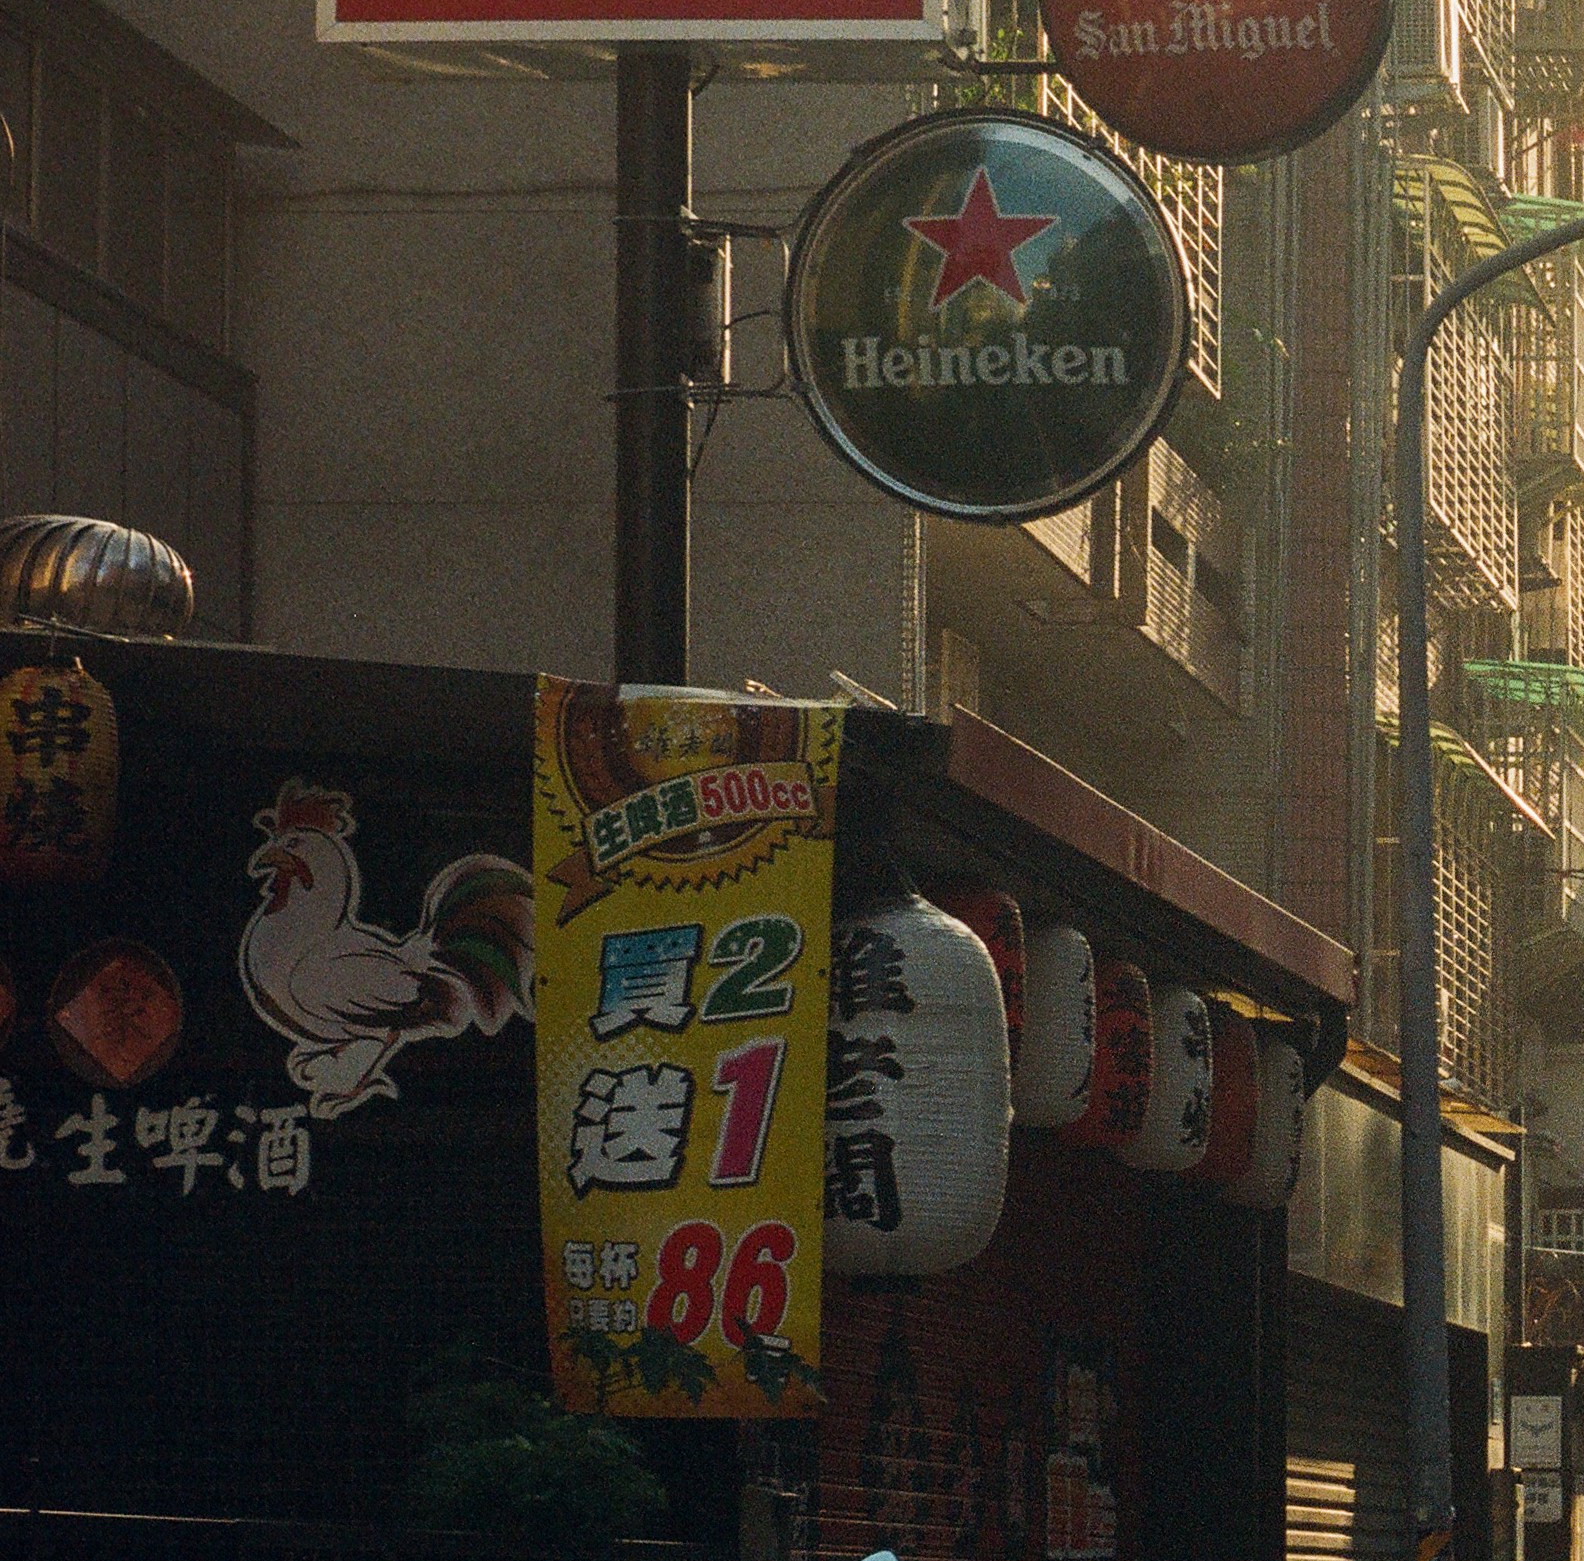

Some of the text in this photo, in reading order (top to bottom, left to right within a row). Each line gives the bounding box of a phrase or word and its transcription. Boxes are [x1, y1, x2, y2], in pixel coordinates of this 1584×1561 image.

[1073, 5, 1159, 59] San
[842, 334, 1126, 390] Heineken
[563, 1239, 639, 1291] 每杯
[645, 1219, 799, 1350] 86
